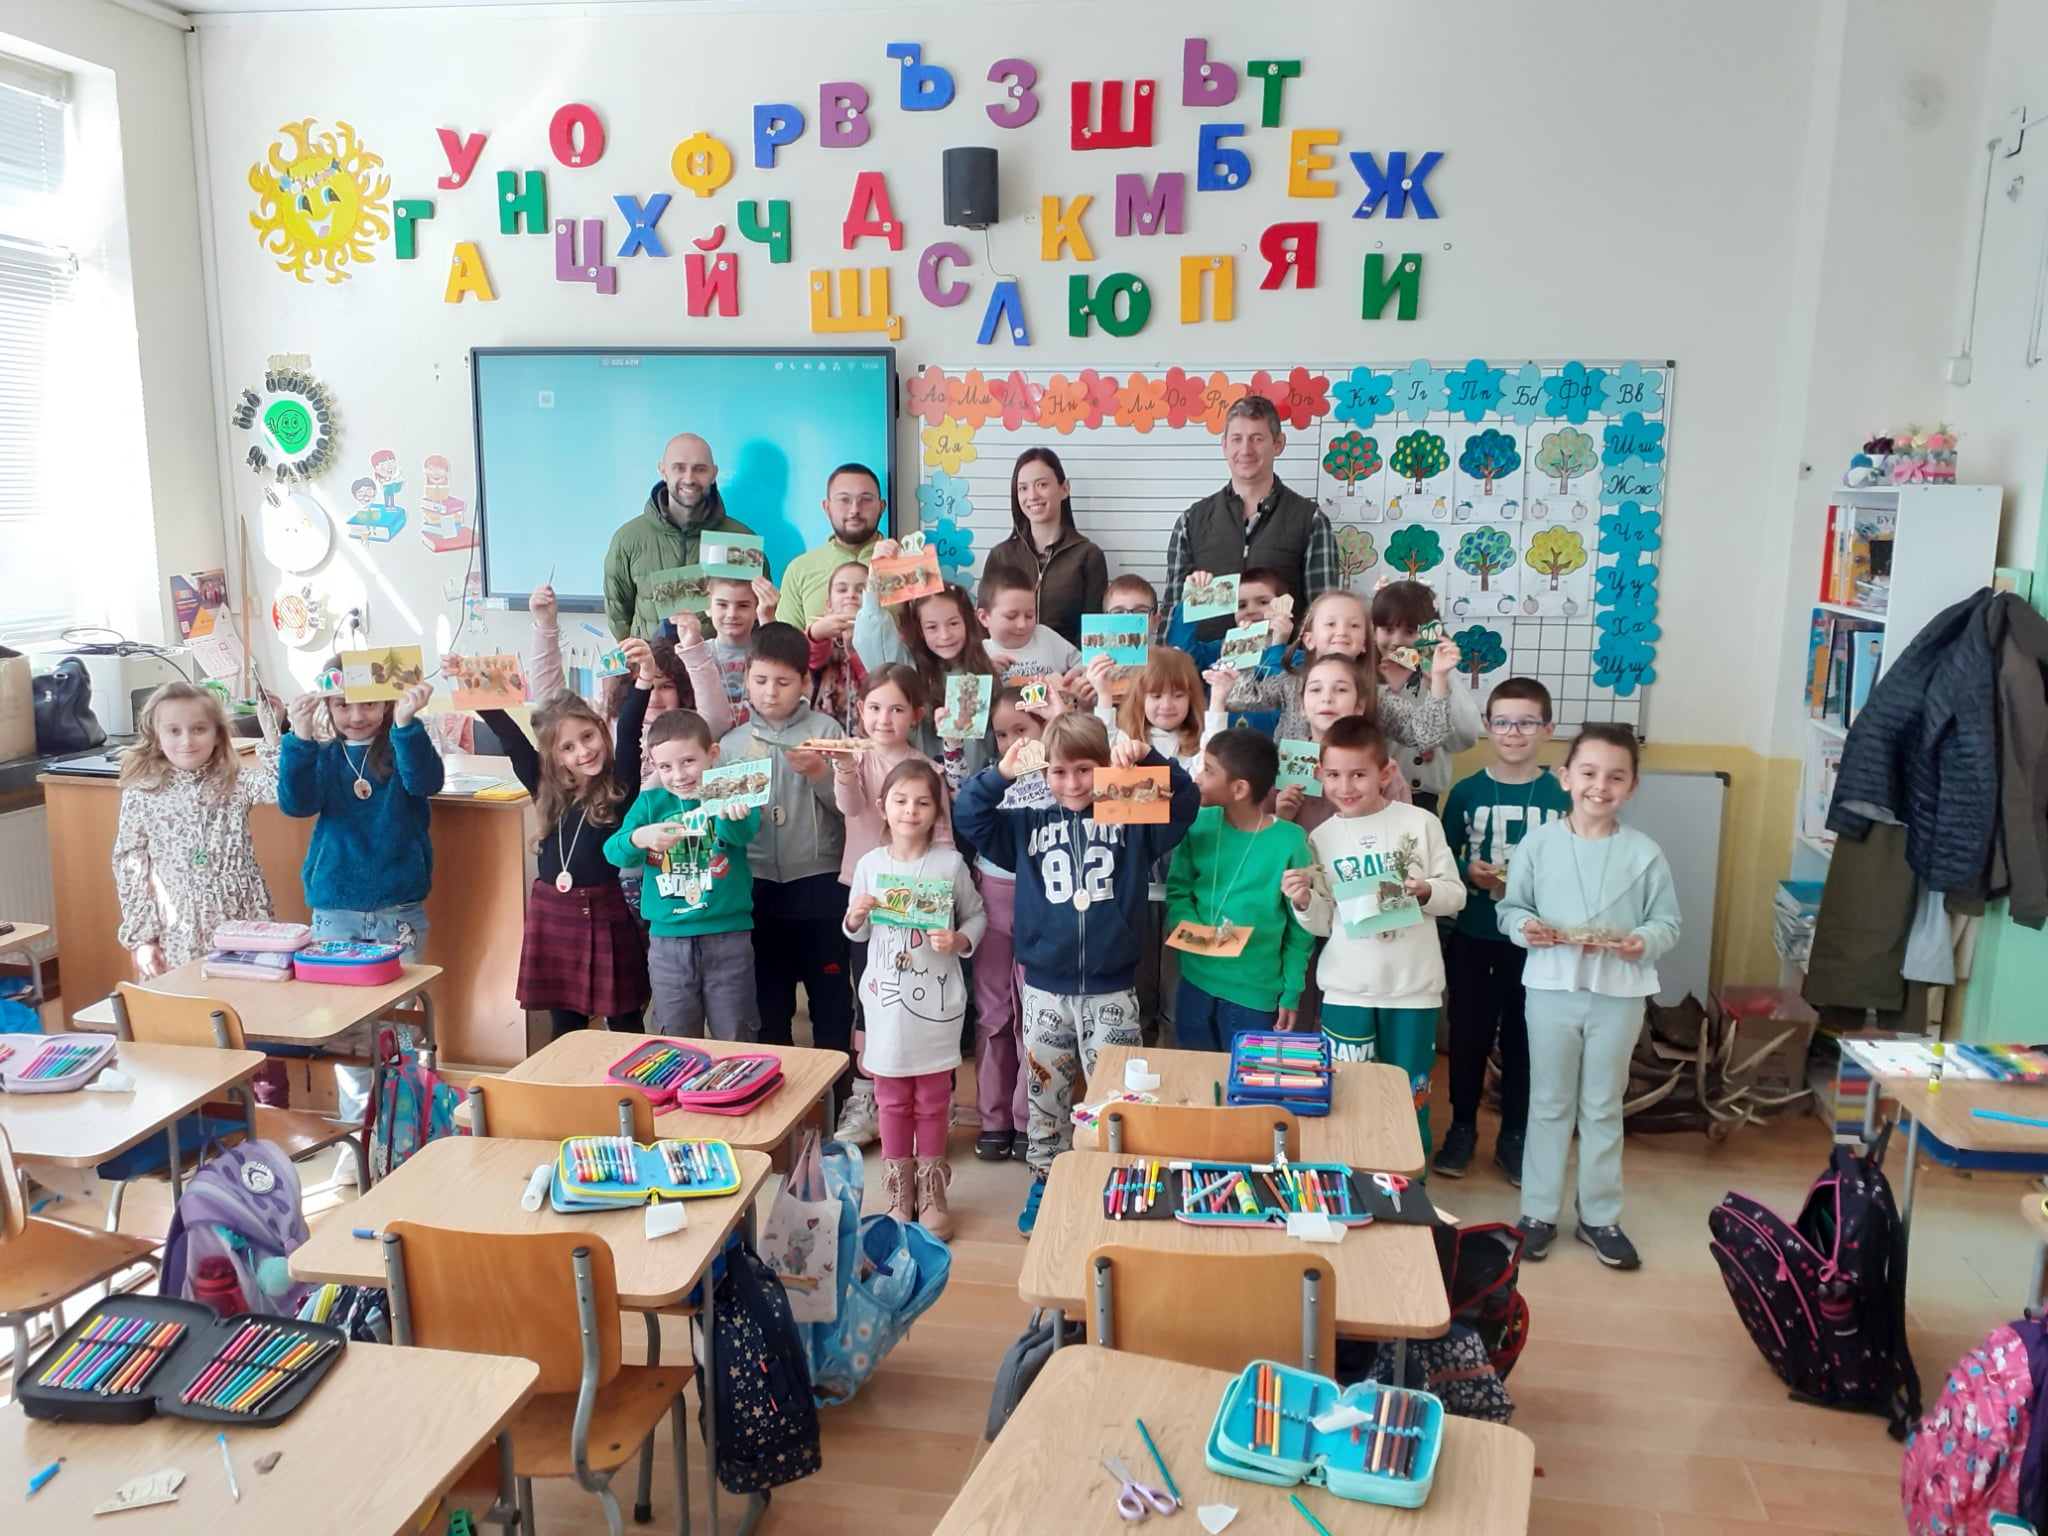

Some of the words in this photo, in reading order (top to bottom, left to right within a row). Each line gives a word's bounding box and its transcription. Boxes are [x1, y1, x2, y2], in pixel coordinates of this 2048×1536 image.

[886, 42, 955, 111] Ъ
[986, 58, 1039, 128] З
[1183, 38, 1238, 106] Ь
[1247, 60, 1301, 127] Т
[549, 103, 606, 168] О
[753, 103, 805, 168] Р
[820, 82, 869, 148] В
[1071, 79, 1156, 150] Ш
[436, 128, 487, 190] У
[671, 131, 735, 198] Ф
[1197, 124, 1251, 191] Б
[1288, 129, 1340, 198] Е
[1350, 152, 1445, 220] Ж
[393, 199, 434, 260] Г
[497, 170, 548, 235] Н
[613, 193, 672, 258] Х
[737, 200, 792, 264] Ч
[842, 172, 903, 251] Д
[1041, 195, 1094, 261] К
[1115, 173, 1184, 236] М
[443, 242, 499, 304] А
[555, 218, 617, 295] Ц
[685, 225, 740, 318] Й
[918, 242, 971, 307] С
[1260, 222, 1318, 290] Я
[1361, 252, 1423, 321] И
[810, 267, 903, 342] Щ
[976, 281, 1031, 346] Л
[1068, 272, 1152, 338] Ю
[1180, 255, 1235, 324] П
[920, 384, 948, 403] Аа
[957, 386, 993, 405] Мм
[1049, 395, 1079, 415] Нн
[1128, 392, 1155, 414] Лл
[1167, 388, 1187, 406] Оо
[1205, 390, 1230, 419] Рр
[1346, 387, 1380, 409] Кк
[1407, 380, 1428, 401] Гг
[1458, 380, 1492, 401] Пп
[1512, 385, 1543, 406] Бб
[1559, 376, 1592, 410] Фф
[1616, 382, 1645, 404] Вв
[936, 434, 963, 455] Яя
[1611, 433, 1655, 454] Шш
[1607, 474, 1653, 495] Жж
